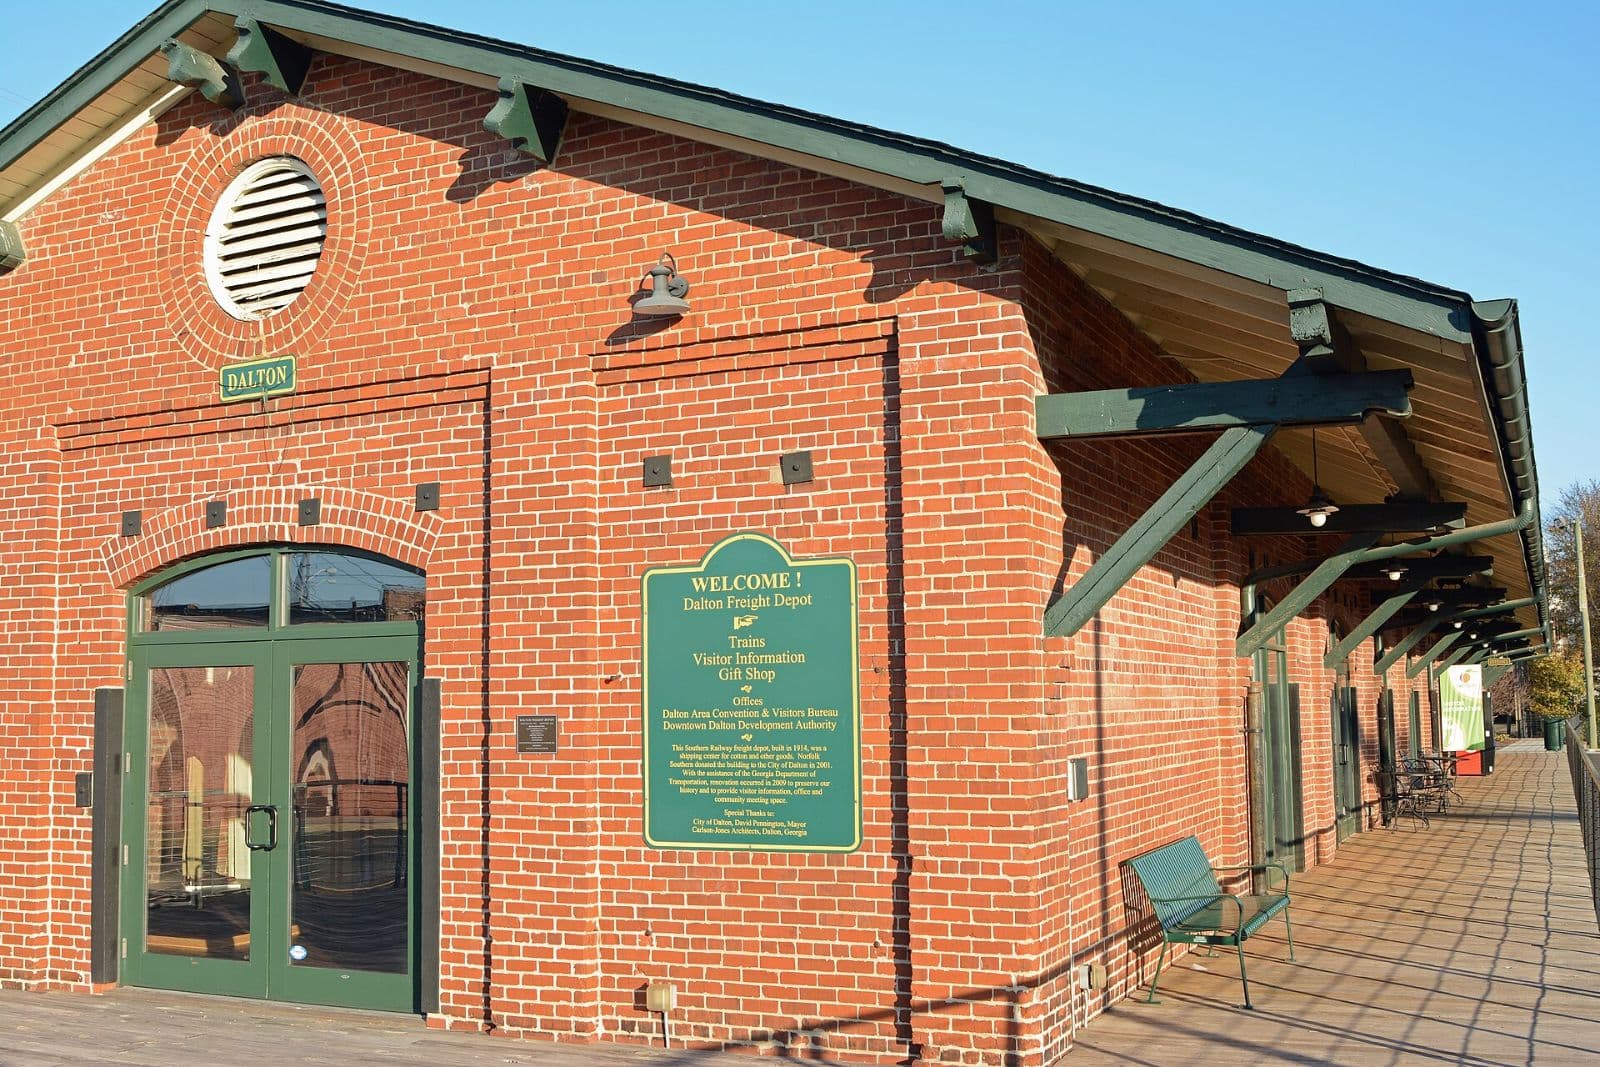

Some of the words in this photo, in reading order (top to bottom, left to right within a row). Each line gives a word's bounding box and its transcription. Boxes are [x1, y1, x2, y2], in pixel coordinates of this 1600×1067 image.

[228, 366, 287, 392] DALTON
[692, 573, 790, 592] WELCOME
[683, 598, 722, 610] Dalton
[727, 595, 770, 610] Freight
[774, 594, 812, 609] Depot
[728, 636, 765, 648] Trains
[693, 653, 732, 666] Visitor
[736, 651, 805, 664] Information
[719, 668, 742, 681] Gift
[746, 668, 775, 682] Shop
[732, 697, 763, 706] Offices
[663, 710, 688, 718] Dalton
[691, 709, 710, 718] Area
[712, 709, 759, 718] Convention
[772, 708, 805, 717] Visitors
[808, 708, 838, 716] Bureau
[664, 721, 706, 730] Downtown
[709, 721, 736, 730] Dalton
[738, 720, 793, 731] Development
[796, 720, 836, 730] Authority
[710, 744, 732, 752] Railway
[724, 809, 744, 817] Special
[787, 820, 807, 828] Mayor
[784, 829, 807, 838] Georgia
